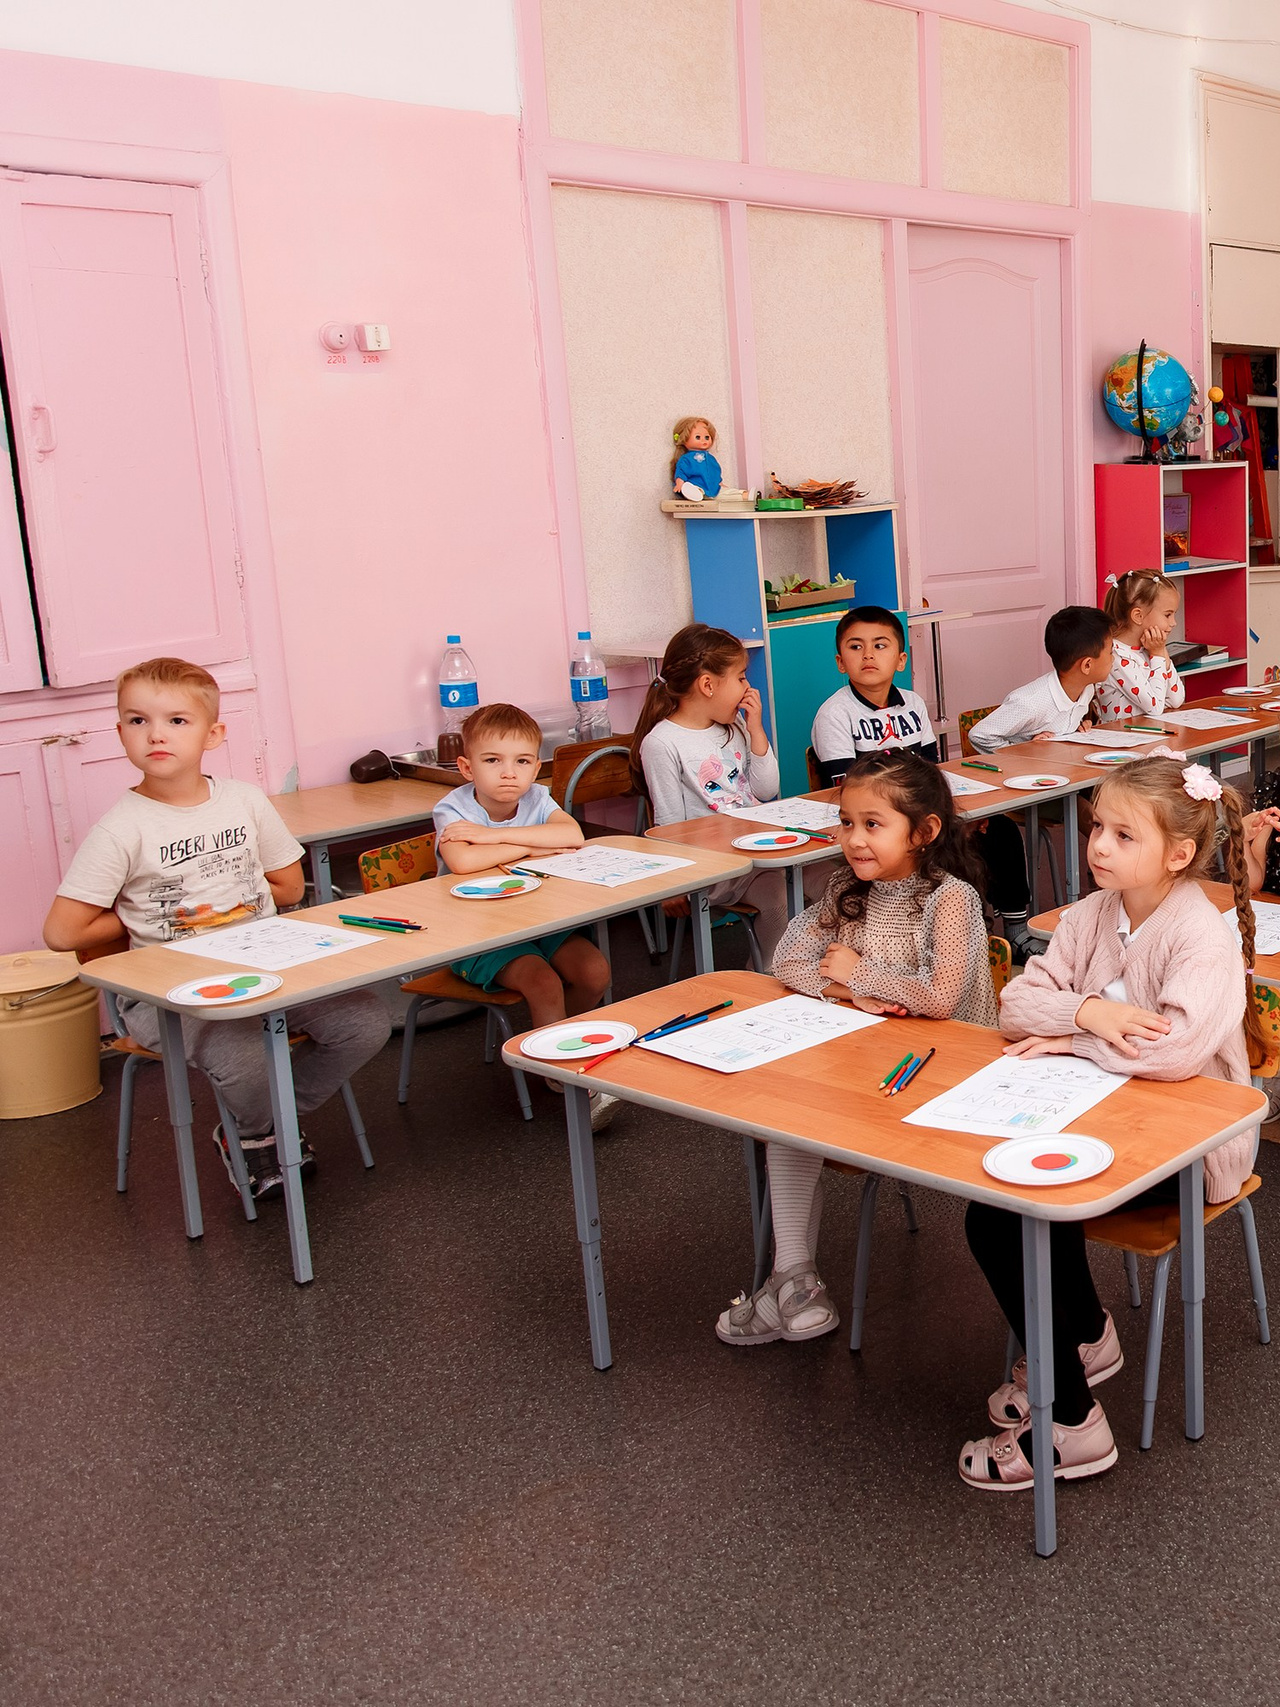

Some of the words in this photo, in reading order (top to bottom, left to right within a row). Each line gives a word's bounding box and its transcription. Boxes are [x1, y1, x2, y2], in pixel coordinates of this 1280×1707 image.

[160, 834, 206, 864] DESERT
[211, 825, 247, 849] VIBES
[320, 851, 330, 864] 2
[701, 897, 709, 913] 2
[274, 1018, 285, 1034] 2
